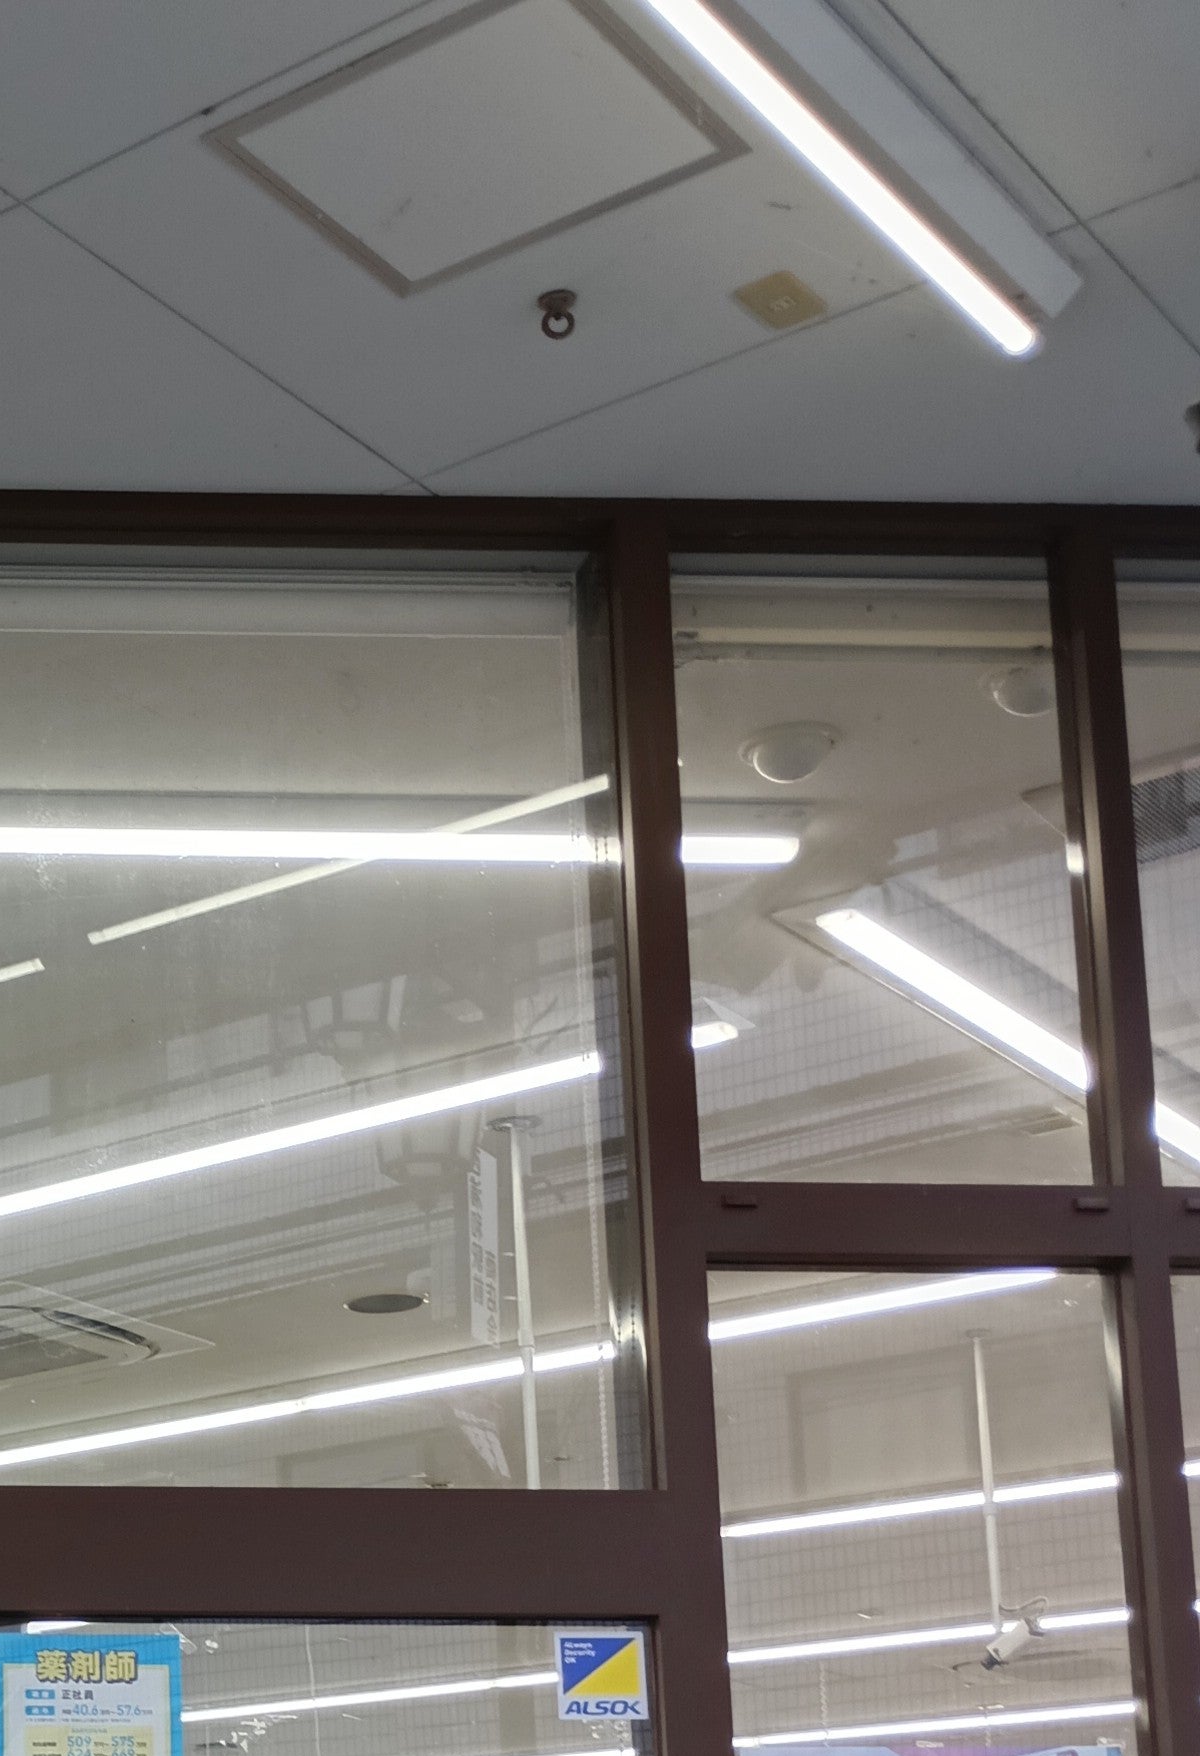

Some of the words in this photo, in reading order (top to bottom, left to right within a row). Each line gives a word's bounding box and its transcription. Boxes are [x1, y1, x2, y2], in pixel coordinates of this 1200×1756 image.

[36, 1649, 138, 1684] 薬剤師
[62, 1689, 94, 1700] 正社員
[565, 1700, 641, 1715] ALSOK
